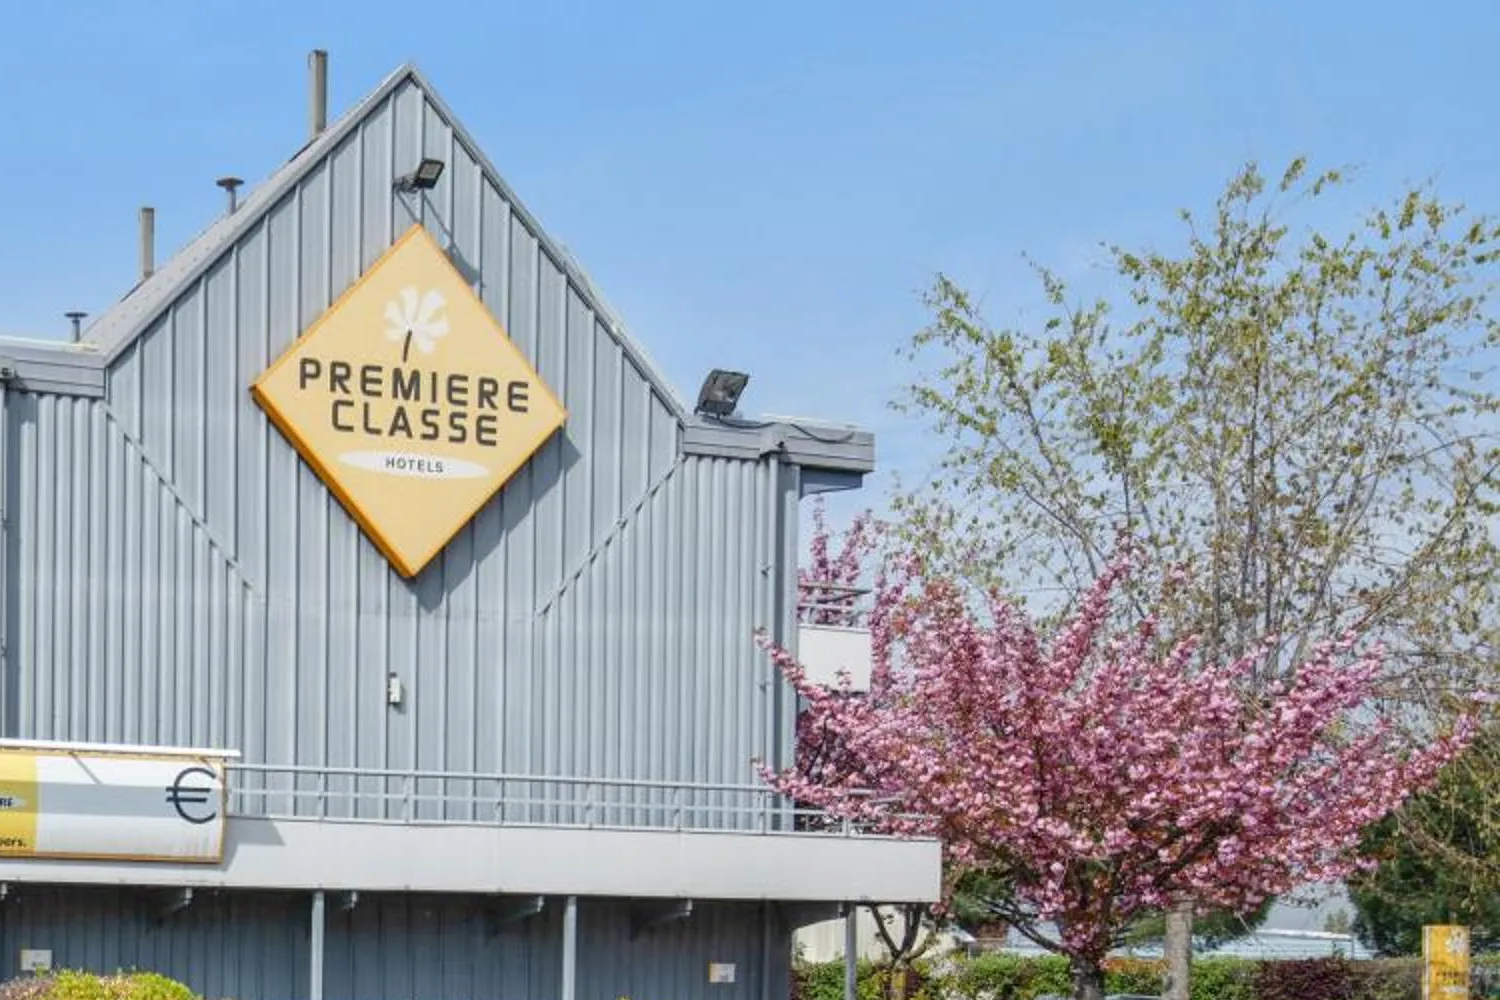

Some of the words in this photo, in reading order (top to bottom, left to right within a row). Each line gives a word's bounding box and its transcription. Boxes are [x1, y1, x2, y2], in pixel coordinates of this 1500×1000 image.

[299, 357, 529, 414] PREMIERE
[331, 400, 498, 447] CLASSE
[385, 457, 444, 474] HOTELS
